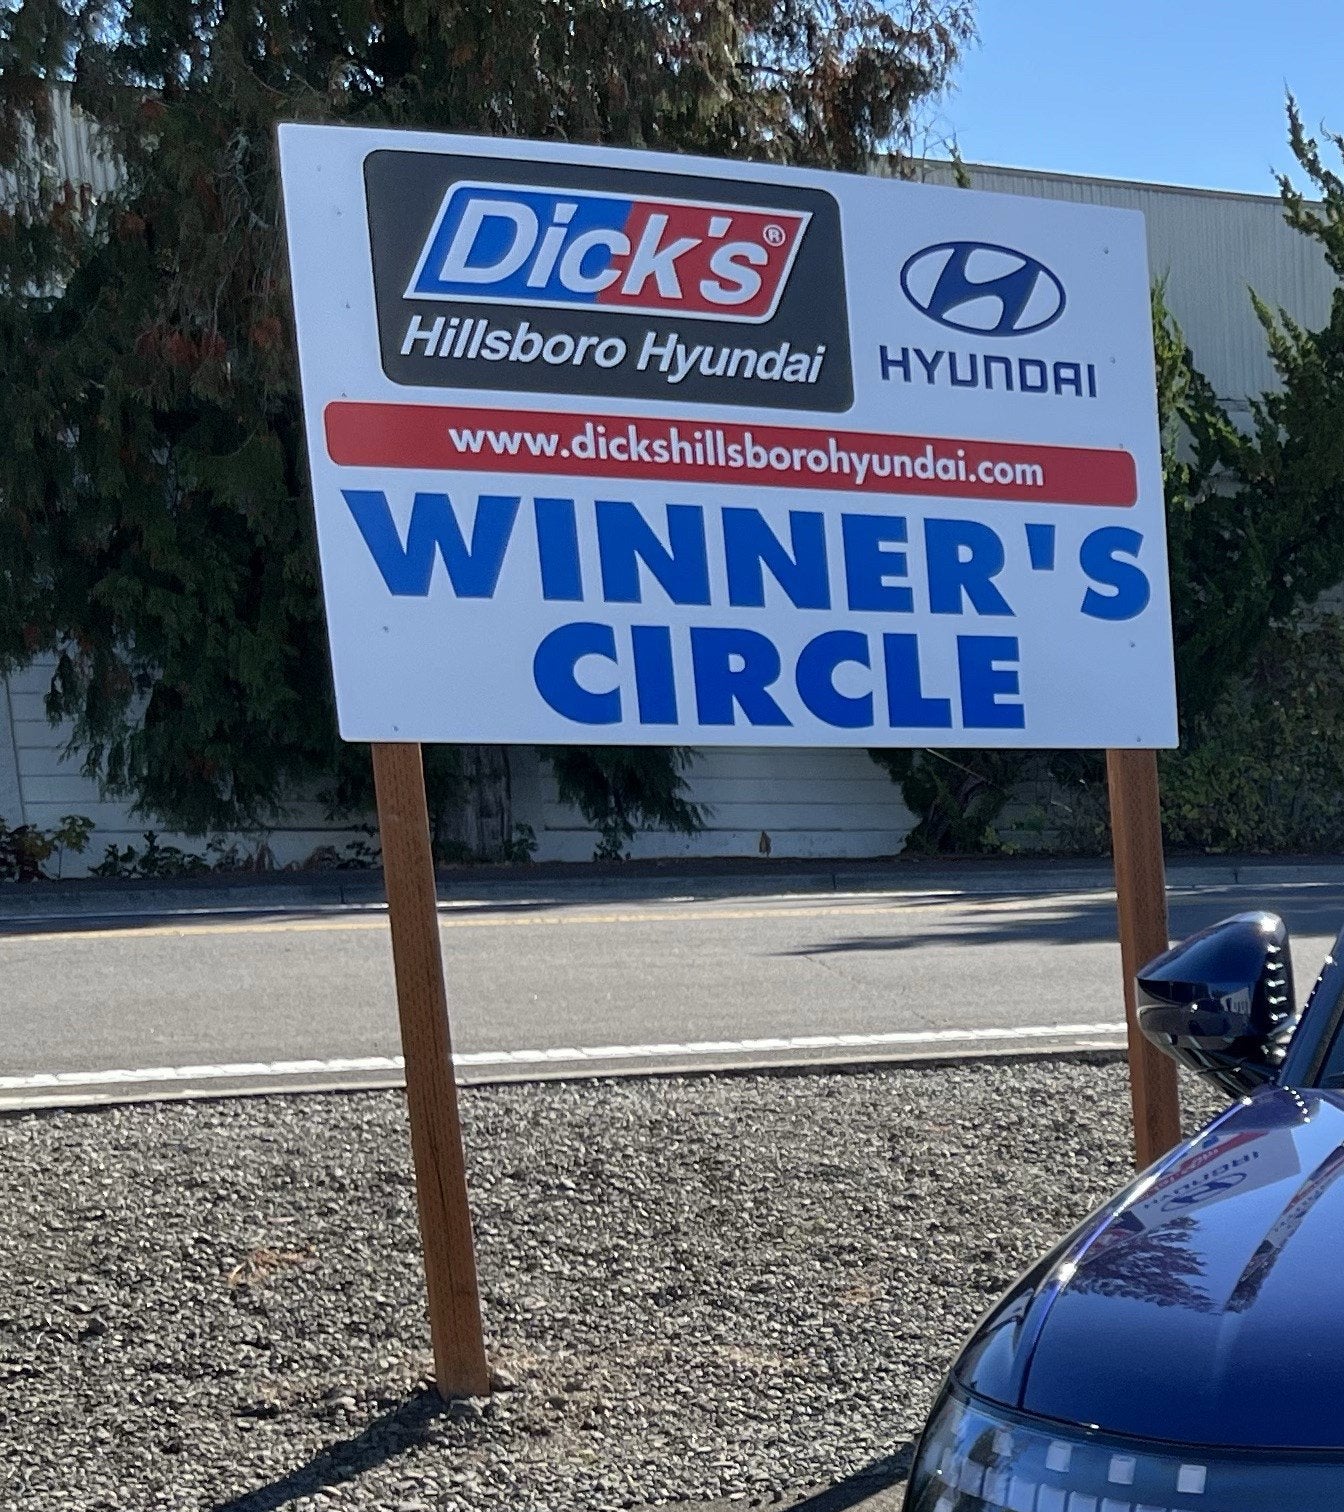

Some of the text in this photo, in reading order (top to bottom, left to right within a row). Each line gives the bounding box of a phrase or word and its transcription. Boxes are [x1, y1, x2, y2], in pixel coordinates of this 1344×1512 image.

[399, 315, 826, 384] Hillsboro Hyundai
[879, 345, 1097, 398] HYUNDAI
[448, 423, 1045, 487] www.dickshillsborohyundai.com
[340, 489, 1151, 621] WINNER'S
[533, 621, 1026, 730] CIRCLE
